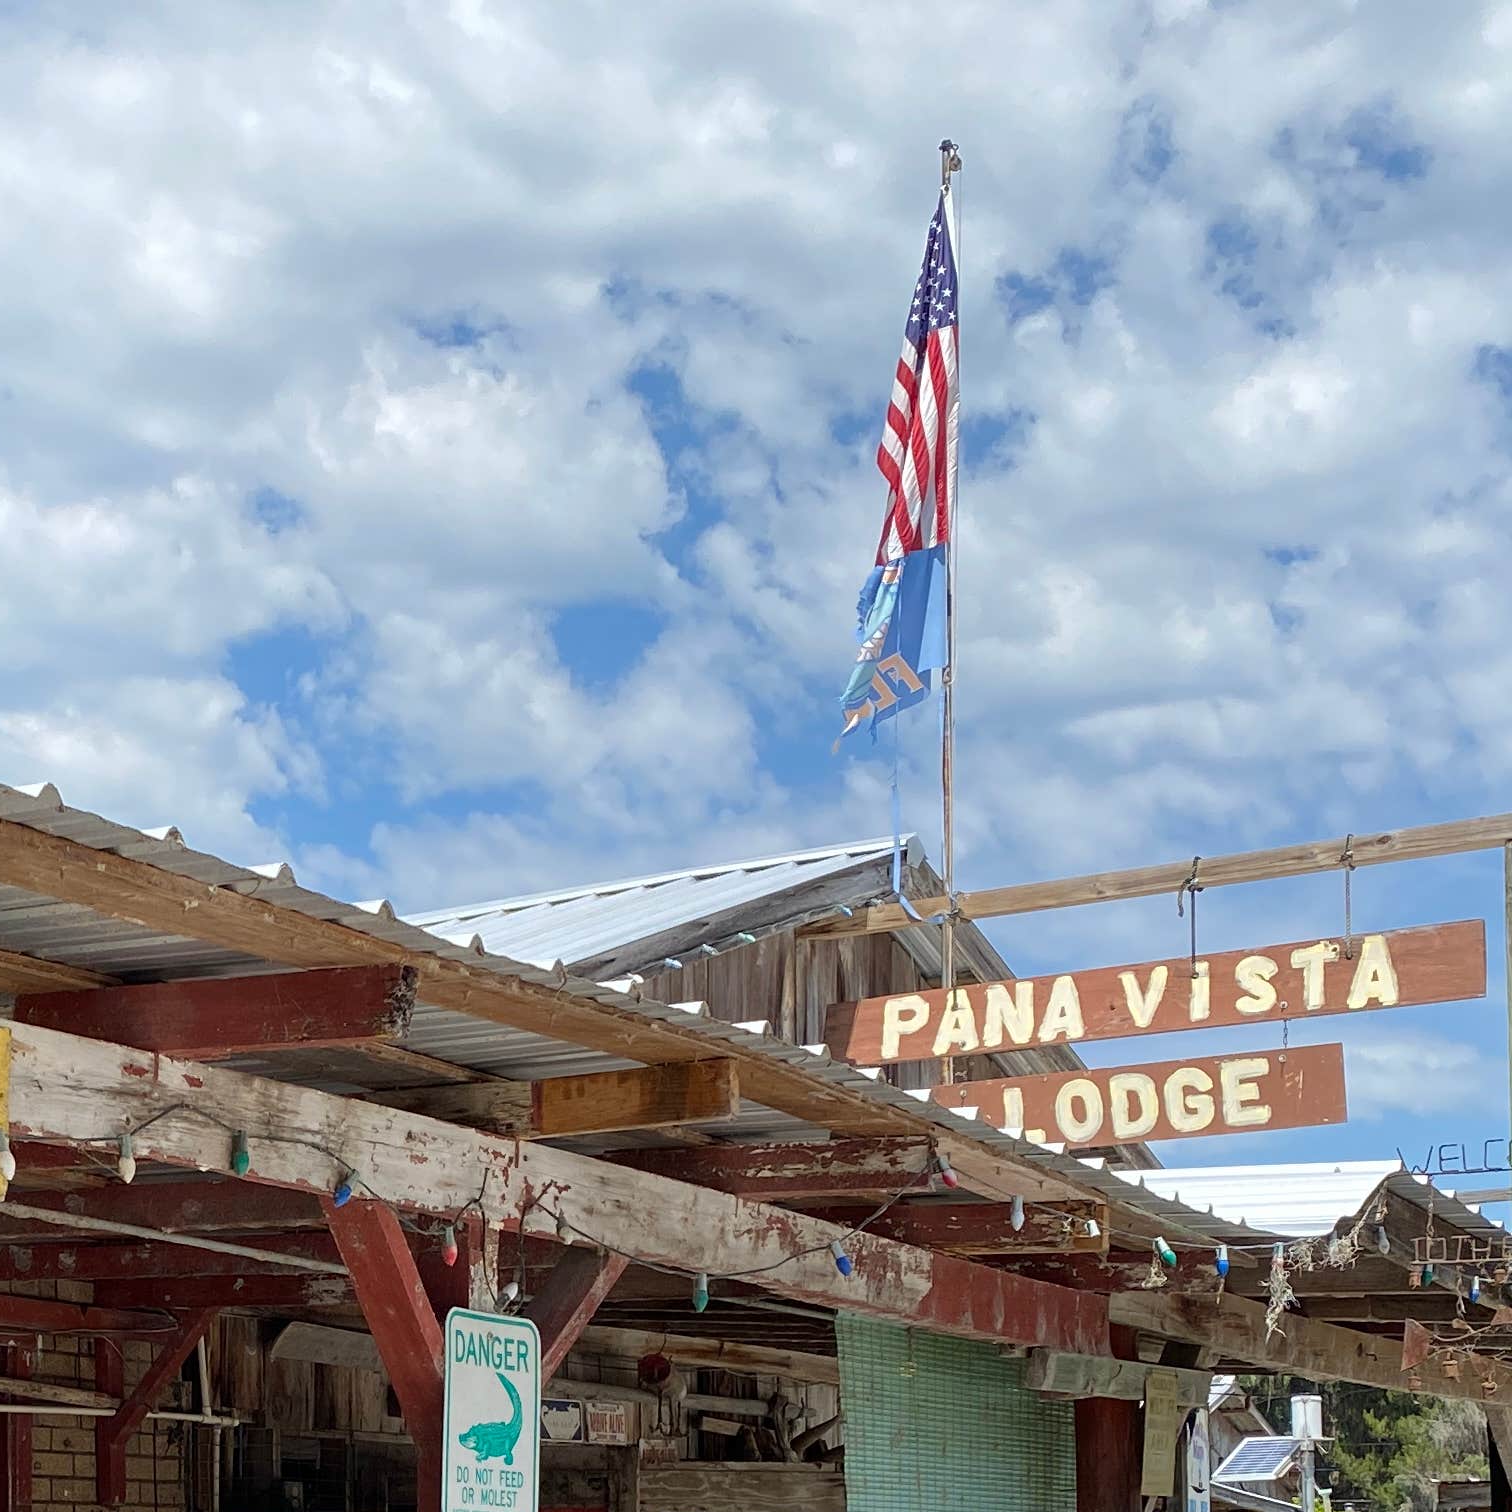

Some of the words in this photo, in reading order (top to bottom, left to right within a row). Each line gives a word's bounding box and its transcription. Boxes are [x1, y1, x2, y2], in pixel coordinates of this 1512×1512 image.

[881, 974, 1085, 1060] PANA
[1118, 933, 1400, 1029] VISTA
[1002, 1056, 1272, 1145] LODGE
[455, 1329, 529, 1373] DANGER
[456, 1466, 469, 1483] DO
[475, 1468, 494, 1486] NOT
[499, 1470, 524, 1488] FEED
[461, 1487, 475, 1504] OR
[480, 1488, 518, 1508] MOLEST
